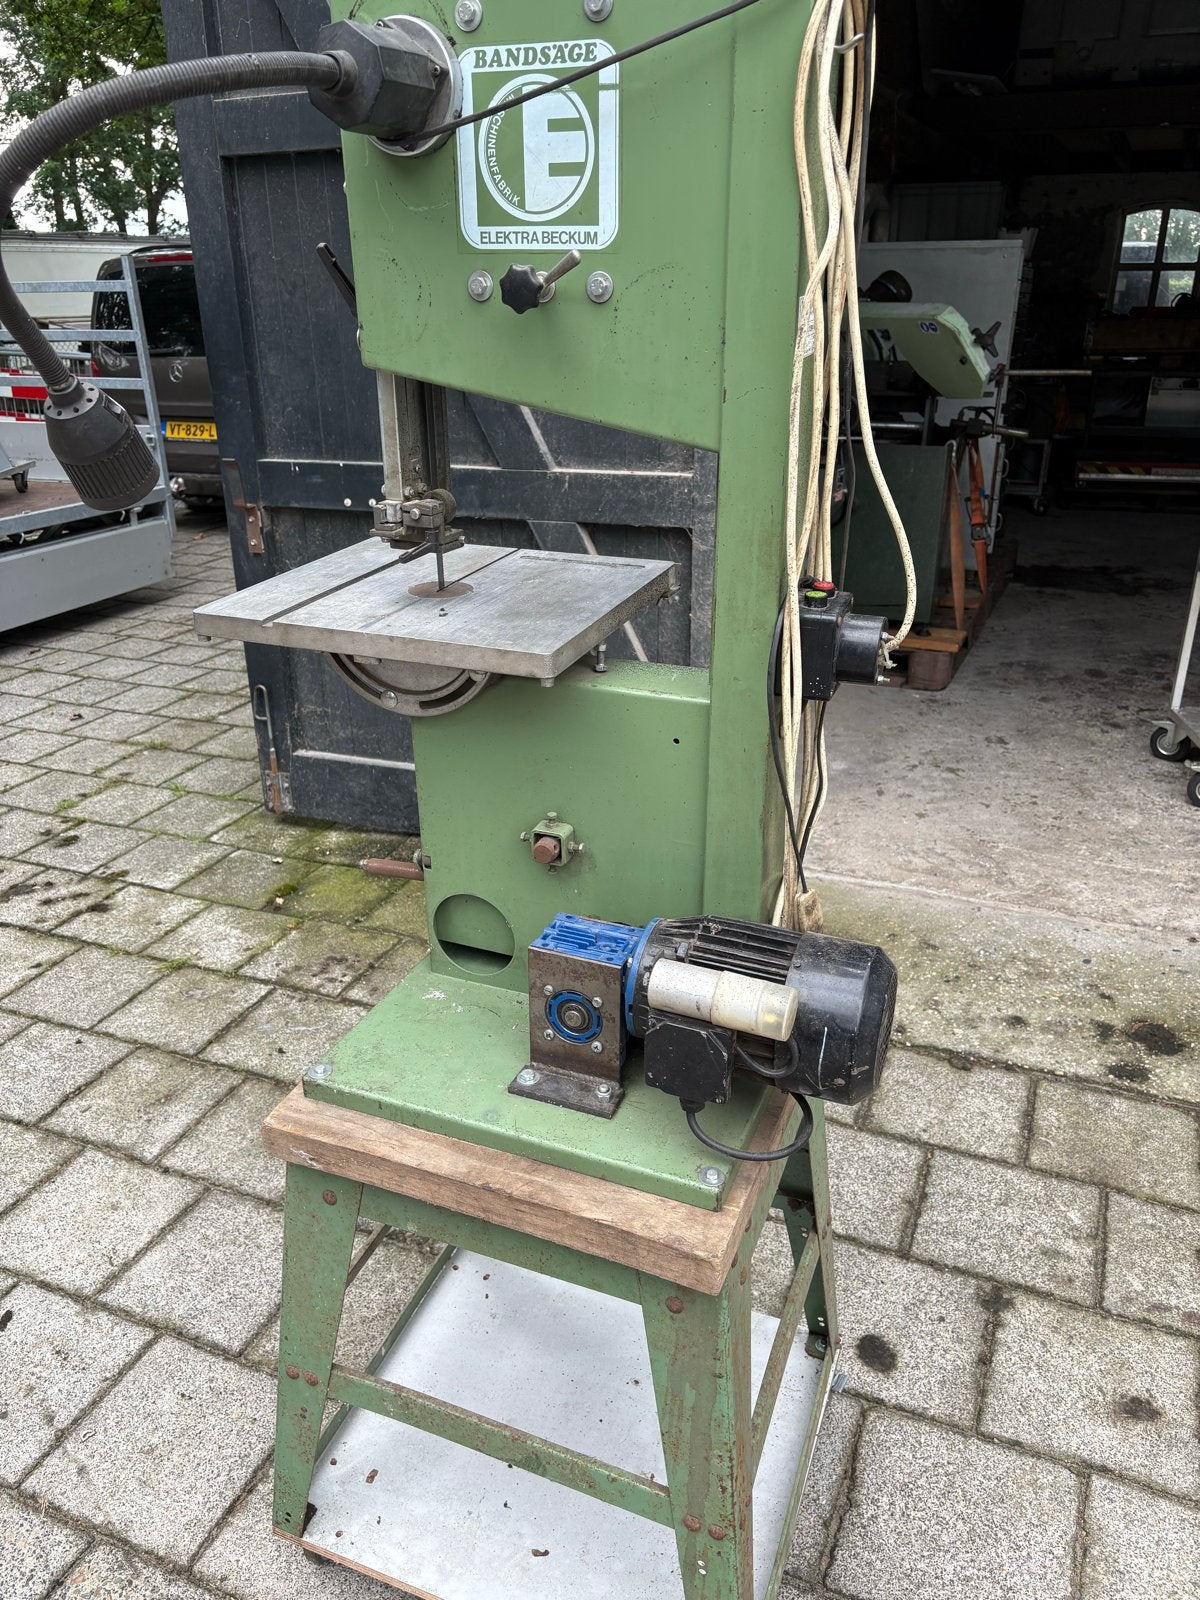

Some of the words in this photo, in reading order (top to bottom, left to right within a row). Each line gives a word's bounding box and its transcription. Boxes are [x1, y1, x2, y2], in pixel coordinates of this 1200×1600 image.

[474, 42, 597, 69] BANDSÄGE
[488, 94, 521, 206] SCHINENFABRIK
[480, 231, 540, 245] ELEKTRA
[542, 231, 598, 245] BECKUM
[169, 423, 214, 437] VT-829-L
